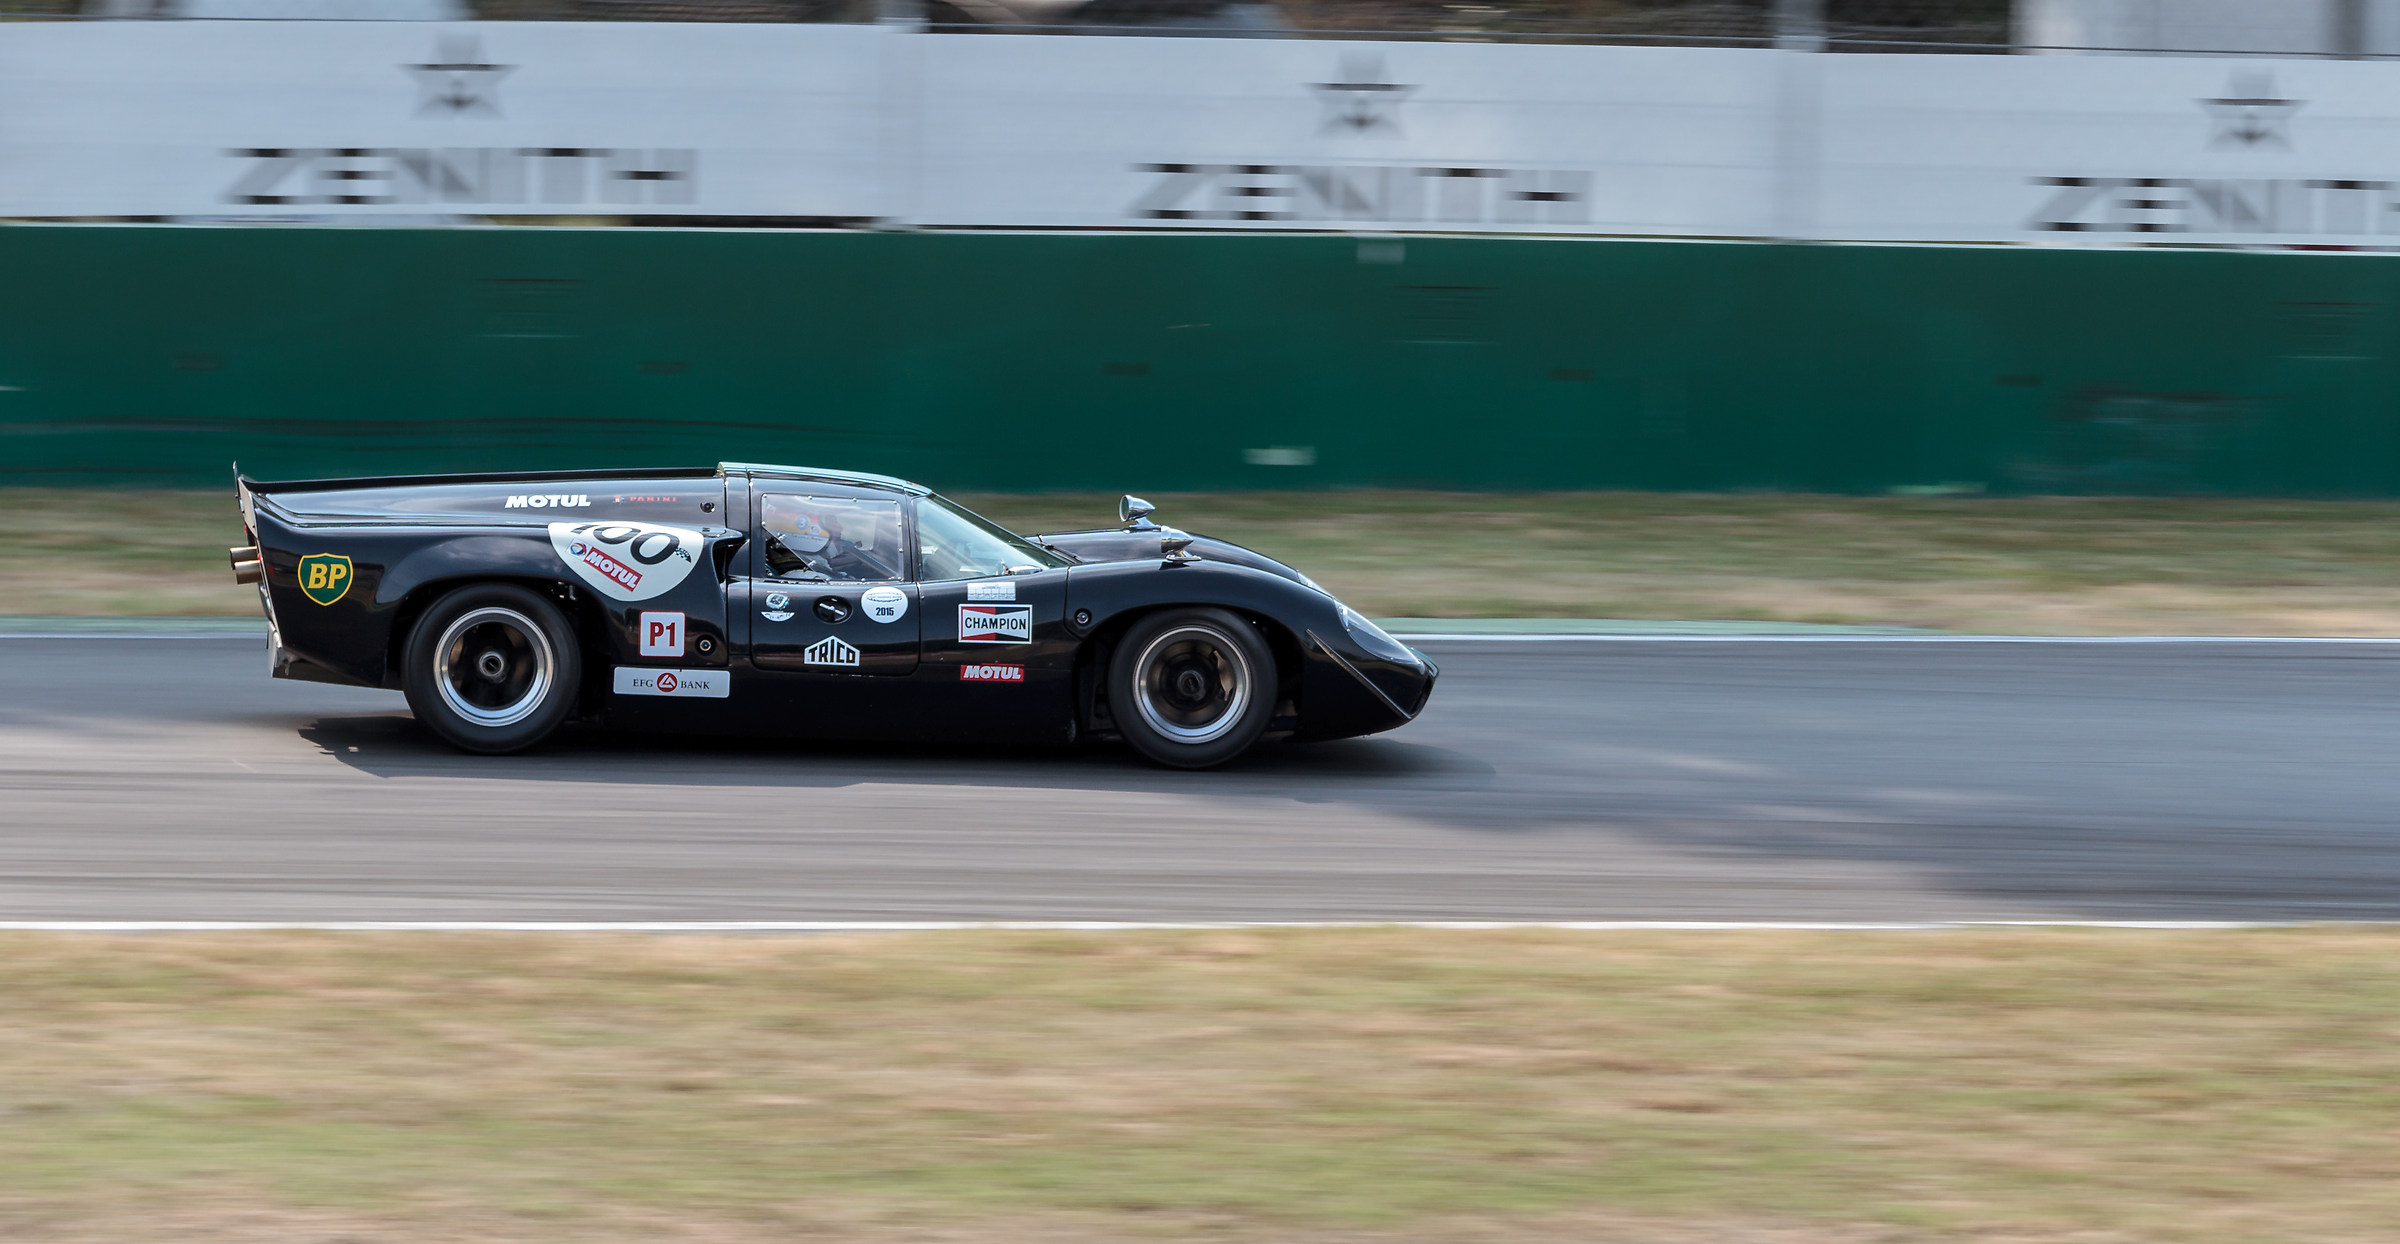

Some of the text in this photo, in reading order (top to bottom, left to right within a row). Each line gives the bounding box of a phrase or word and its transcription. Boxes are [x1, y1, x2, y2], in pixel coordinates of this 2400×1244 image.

[220, 147, 698, 205] ZENITH
[1127, 163, 1594, 225] ZENITH
[2022, 176, 2400, 235] ZENIT
[504, 494, 592, 509] MOTUL
[307, 563, 348, 589] BP
[585, 549, 638, 589] MOTUL
[875, 607, 895, 616] 2015
[965, 617, 1026, 630] CHAMPION
[649, 622, 676, 647] P1
[808, 638, 857, 664] TRICO
[632, 678, 710, 690] EFG BANK
[963, 665, 1022, 680] MOTUL
